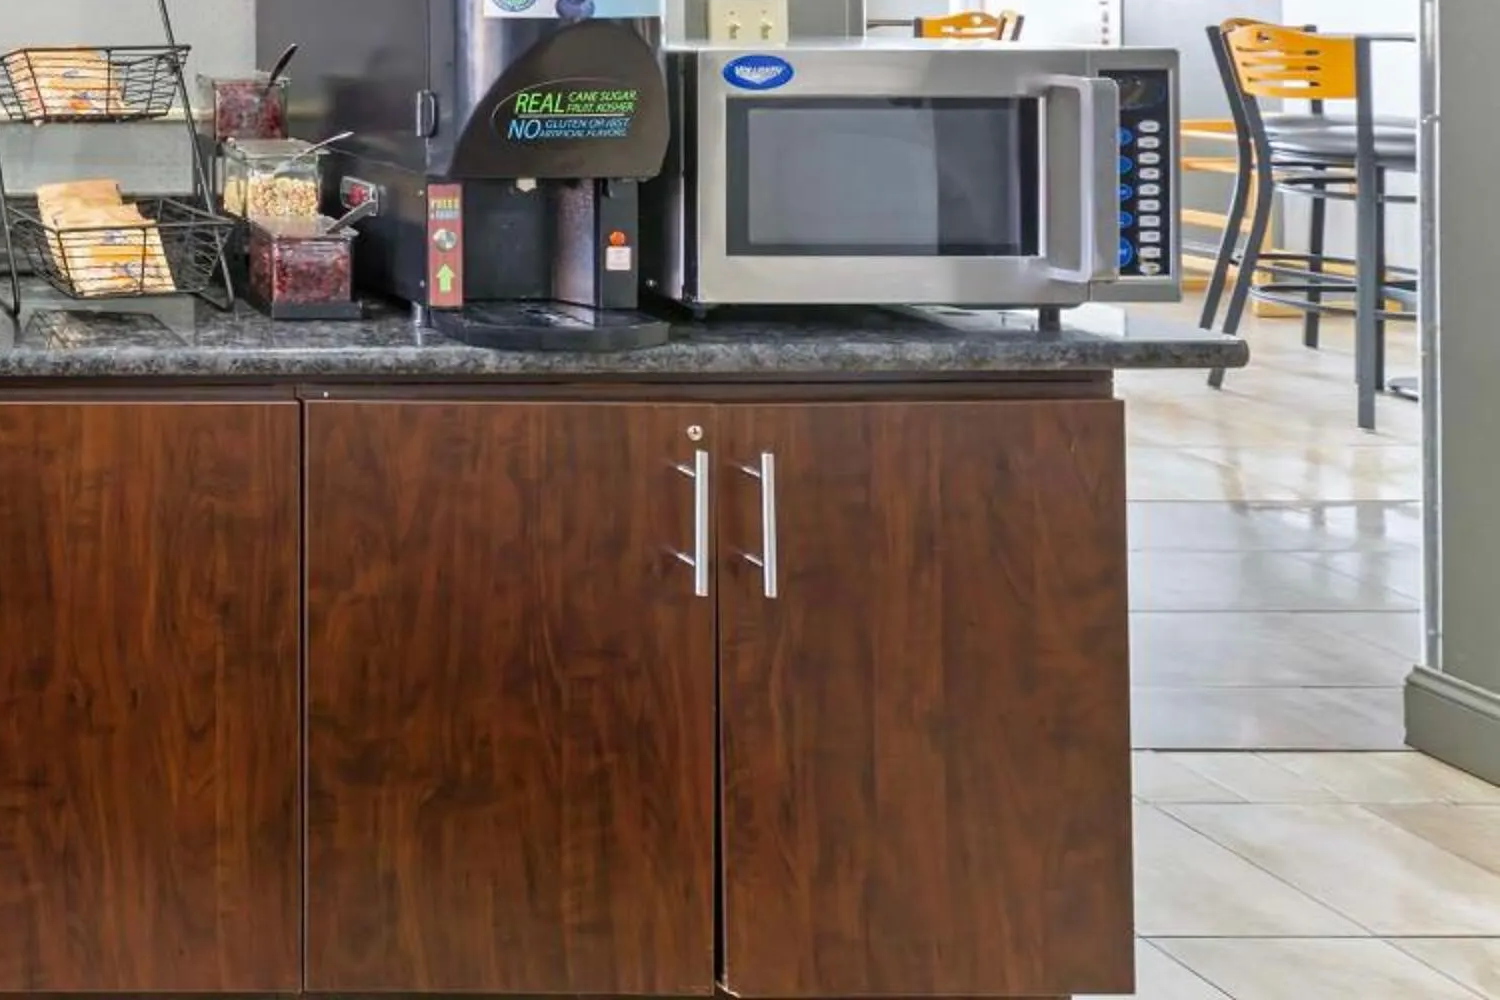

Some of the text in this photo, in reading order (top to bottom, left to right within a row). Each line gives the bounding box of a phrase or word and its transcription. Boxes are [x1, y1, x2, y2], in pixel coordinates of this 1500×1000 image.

[515, 90, 638, 114] REAL CANE SUGAR
[507, 119, 541, 140] NO
